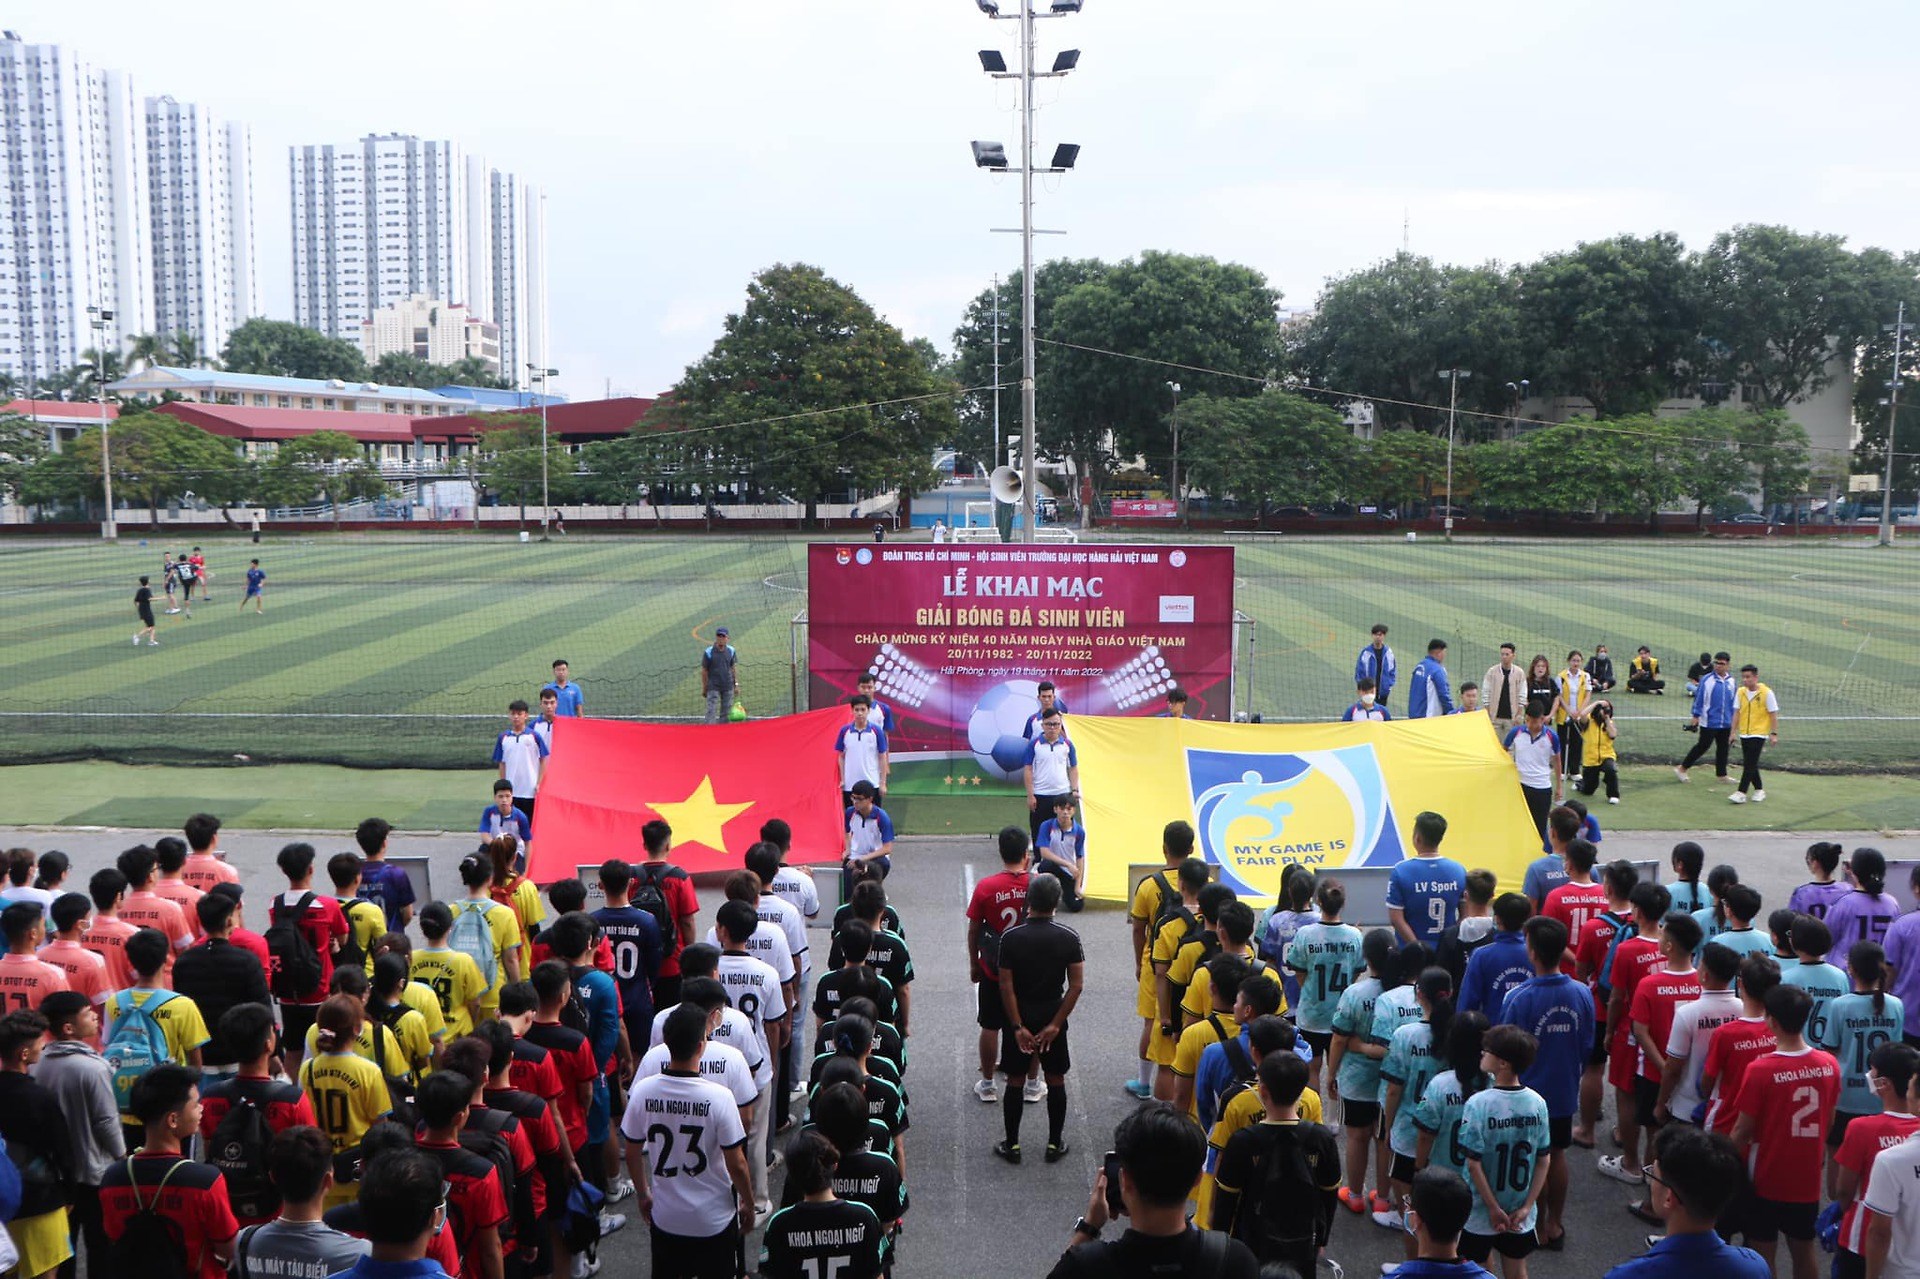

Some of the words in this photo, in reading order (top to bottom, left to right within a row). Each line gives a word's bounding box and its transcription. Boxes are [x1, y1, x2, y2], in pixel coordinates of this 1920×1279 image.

[905, 552, 923, 561] TNCS
[951, 552, 970, 561] MINH
[991, 552, 1008, 561] SINH
[1010, 550, 1026, 562] VIÊN
[1073, 553, 1087, 564] HỌC
[1089, 551, 1108, 563] HÀNG
[1124, 552, 1140, 565] VIỆT
[1141, 553, 1158, 563] NAM
[943, 567, 968, 596] LỄ
[976, 576, 1038, 597] KHAI
[1047, 577, 1103, 602] MẠC
[917, 603, 951, 626] GIẢI
[957, 605, 1003, 627] BÓNG
[1010, 606, 1032, 627] ĐÁ
[1038, 609, 1079, 628] SINH
[1086, 606, 1124, 628] VIÊN
[855, 632, 888, 644] CHÀO
[891, 633, 927, 645] MỪNG
[950, 633, 979, 646] NIỆM
[983, 635, 997, 645] 40
[1001, 633, 1027, 645] NĂM
[1031, 635, 1064, 646] NGÀY
[1068, 634, 1092, 646] NHÀ
[1096, 634, 1125, 646] GIÁO
[1129, 635, 1155, 647] VIỆT
[1158, 637, 1185, 647] NAM
[947, 650, 1013, 660] 20/11/1982
[1027, 650, 1093, 660] 20/11/2022
[940, 666, 954, 675] Hải
[957, 666, 985, 677] Phòng,
[987, 667, 1009, 678] ngày
[1012, 667, 1022, 675] 19
[1023, 667, 1046, 677] tháng
[1050, 668, 1058, 676] 11
[1061, 668, 1079, 676] năm
[1081, 669, 1103, 677] 2022
[1234, 846, 1262, 855] MY
[1269, 842, 1325, 855] GAME
[1329, 840, 1346, 851] IS
[1237, 857, 1276, 866] FAIR
[1281, 854, 1325, 865] PLAY
[1415, 882, 1428, 893] LV
[1431, 880, 1457, 893] Sport
[1562, 896, 1580, 904] KHOA
[1428, 898, 1446, 933] 9
[1309, 943, 1322, 953] Bùi
[728, 974, 748, 988] NGOẠI
[1657, 985, 1678, 996] KHOA
[1679, 983, 1700, 995] HÀNG
[1698, 1016, 1721, 1029] HÀNG
[1734, 1040, 1757, 1051] KHOA
[709, 1058, 726, 1074] NGỮ
[1773, 1070, 1798, 1083] KHOA
[1799, 1066, 1822, 1080] HÀNG
[313, 1088, 348, 1134] 10
[645, 1098, 664, 1112] KHOA
[666, 1100, 691, 1118] NGOẠI
[692, 1099, 711, 1117] NGỮ
[1792, 1086, 1819, 1138] 2
[647, 1123, 707, 1177] 23
[1495, 1141, 1532, 1192] 16
[832, 1178, 858, 1196] NGOẠI
[860, 1175, 880, 1194] NGỮ
[788, 1231, 812, 1247] KHOA
[815, 1228, 843, 1248] NGOẠI
[845, 1222, 865, 1242] NGỮ
[265, 1256, 284, 1275] MÁY
[287, 1258, 304, 1277] TÀU
[306, 1258, 329, 1279] BIỂN
